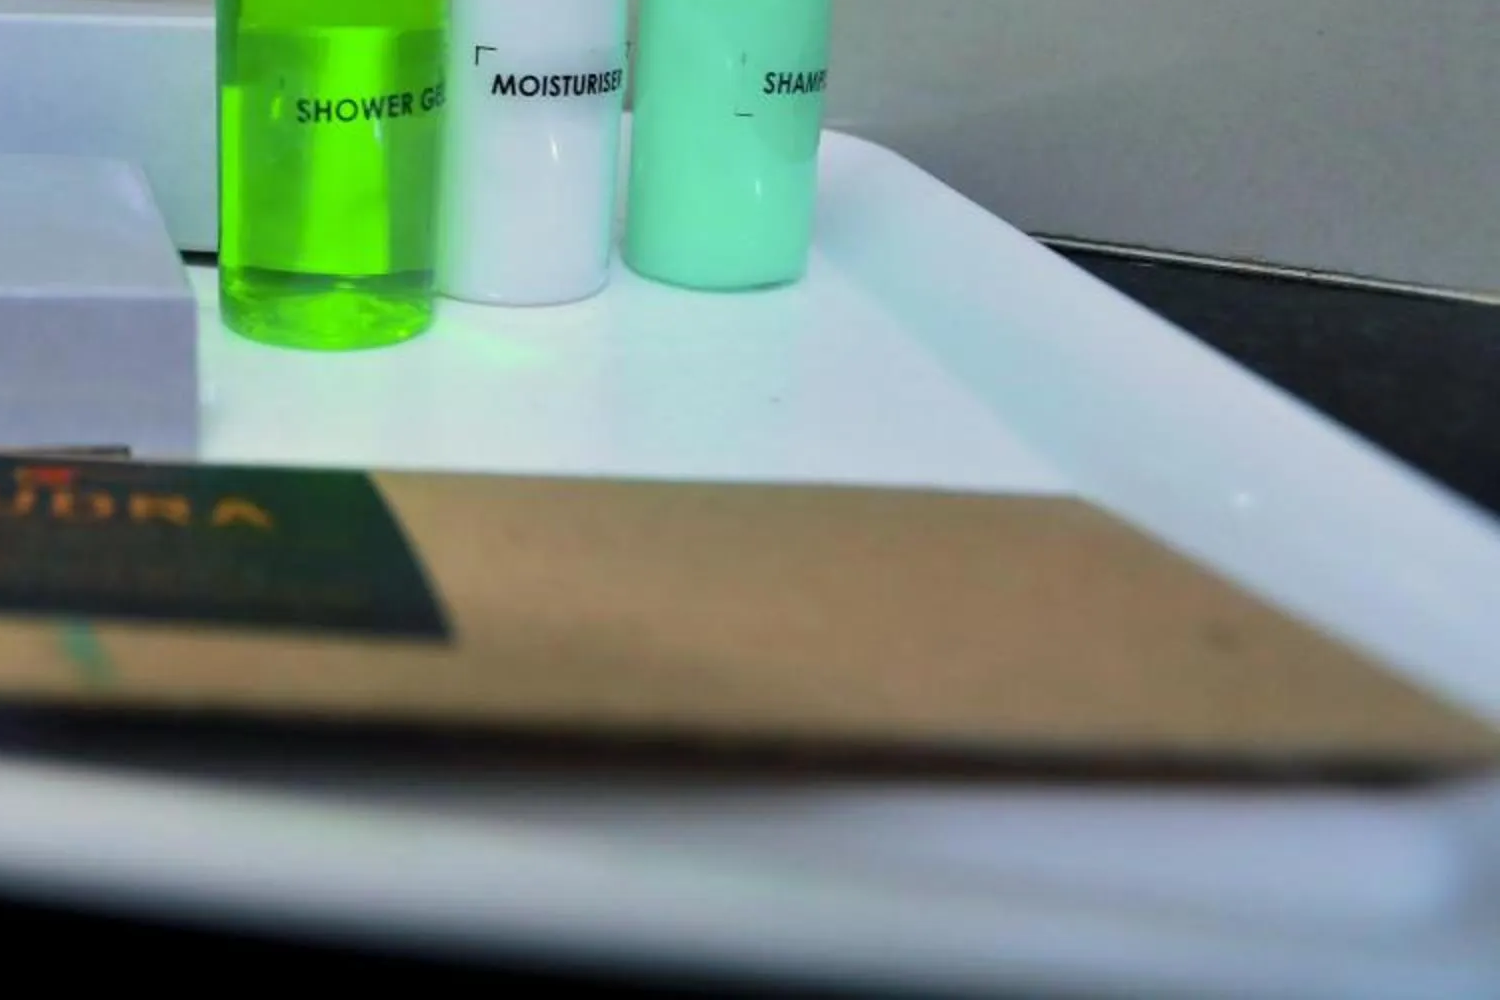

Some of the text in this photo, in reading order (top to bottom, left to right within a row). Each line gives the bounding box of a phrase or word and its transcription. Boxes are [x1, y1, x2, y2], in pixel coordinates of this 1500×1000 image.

[491, 68, 623, 97] MOISTURISER
[763, 69, 828, 95] SHAMP
[296, 91, 414, 123] SHOWER
